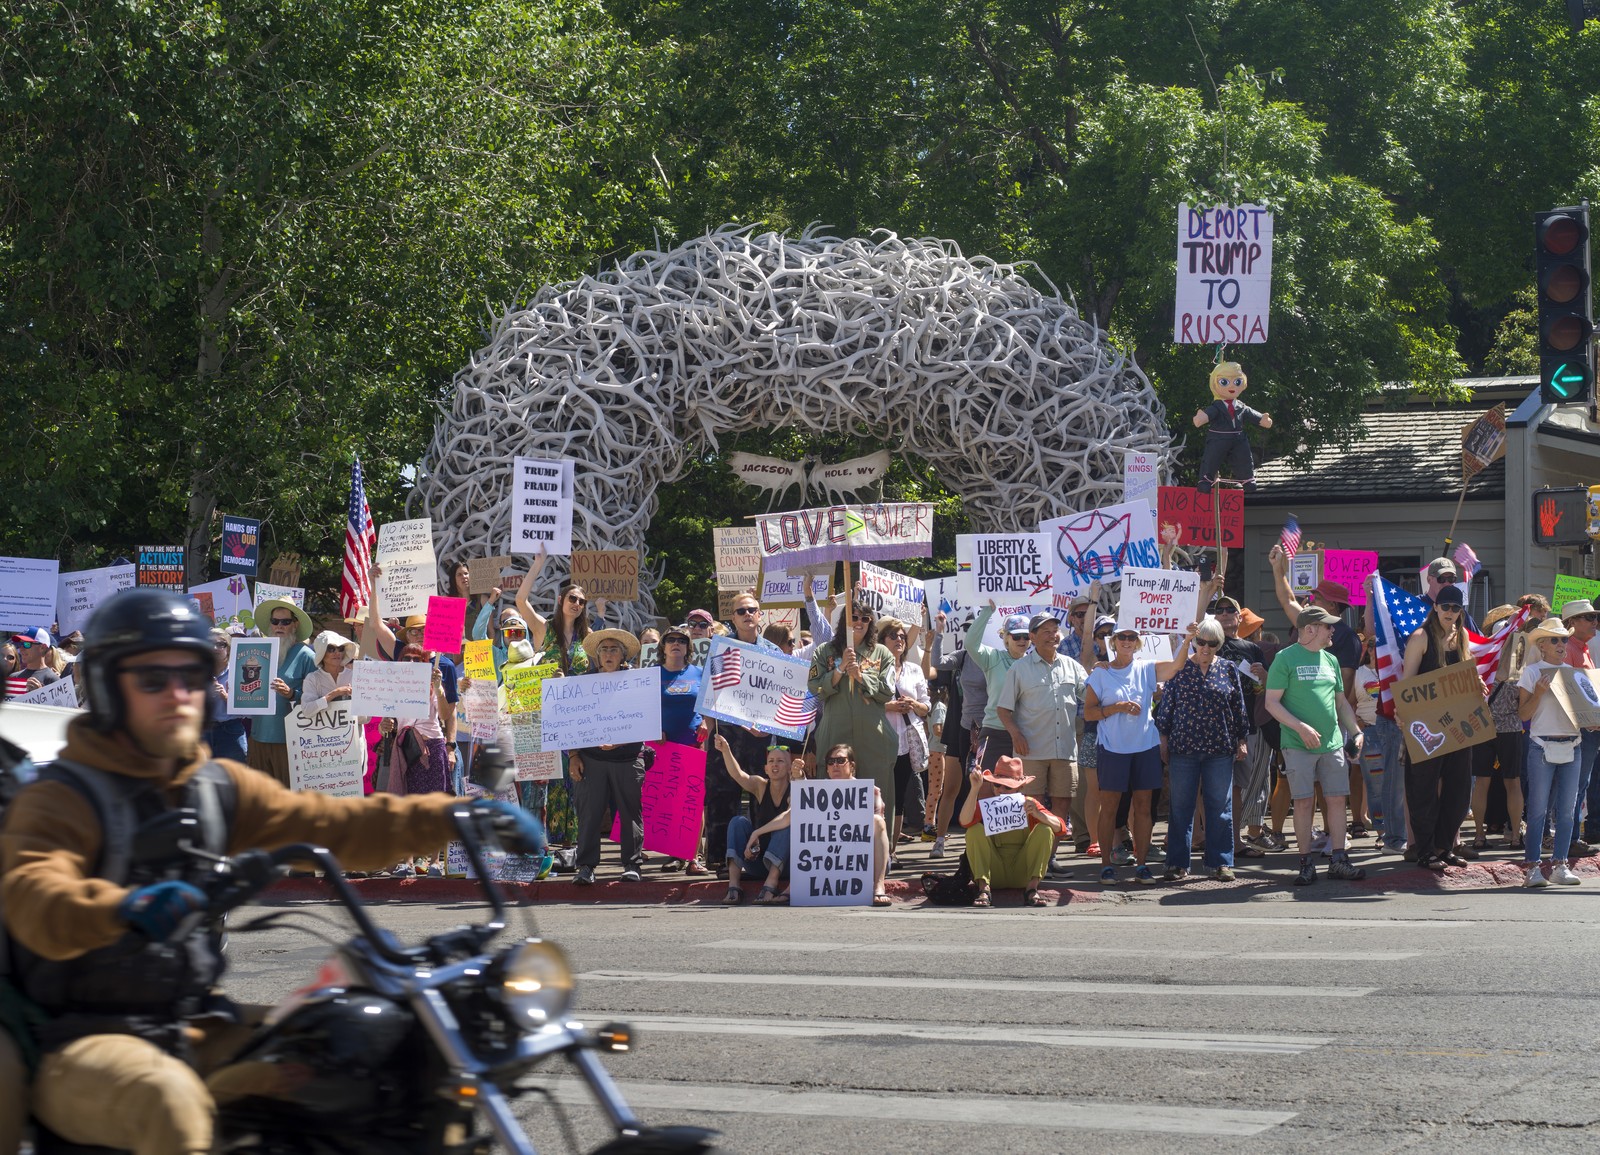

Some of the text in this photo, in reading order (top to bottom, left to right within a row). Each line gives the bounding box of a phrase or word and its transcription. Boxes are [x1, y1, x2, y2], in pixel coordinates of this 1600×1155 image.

[1188, 208, 1267, 240] DEPORT
[1182, 241, 1262, 275] TRUMP
[1200, 278, 1240, 310] TO
[1181, 313, 1267, 344] RUSSIA
[1135, 456, 1146, 464] NO
[524, 466, 559, 477] TRUMP
[742, 464, 793, 476] JACKSON
[857, 467, 875, 475] WY
[524, 481, 558, 492] FRAUD
[524, 498, 558, 507] ABUSER
[1163, 492, 1188, 512] NO
[523, 514, 556, 524] FELON
[225, 522, 257, 535] HANDS OFF
[384, 522, 425, 535] NO KINGS
[522, 529, 554, 540] SCUM
[760, 505, 847, 554] LOVE
[863, 504, 930, 539] POWER
[1188, 526, 1234, 542] TUD
[241, 534, 256, 546] OUR
[720, 547, 751, 556] RUINING
[977, 539, 1037, 555] LIBERTY &
[139, 552, 184, 565] ACTIVIST
[223, 555, 256, 567] DEMOCRACY
[572, 554, 637, 576] NO KINGS
[977, 554, 1042, 576] JUSTICE
[1066, 537, 1161, 587] NO KINGS
[139, 571, 184, 584] HISTORY
[861, 561, 888, 577] LOOKING
[890, 572, 905, 584] FOR
[65, 578, 93, 587] PROTECT
[764, 580, 793, 594] FEDERAL
[978, 576, 1026, 592] FOR ALL
[1172, 579, 1196, 592] About
[1140, 591, 1172, 604] POWER
[998, 605, 1032, 617] PREVENT
[1150, 607, 1169, 616] NOT
[1134, 617, 1178, 629] PEOPLE
[474, 652, 489, 663] NOT
[783, 667, 794, 680] is
[48, 682, 68, 700] TIME
[240, 680, 261, 692] RESIST
[591, 680, 629, 696] CHANGE
[634, 677, 651, 688] THE
[1401, 682, 1437, 703] GIVE
[542, 719, 576, 730] PROTECT
[1438, 711, 1454, 728] THE
[300, 736, 313, 747] DUE
[317, 734, 341, 743] PROCESS
[542, 733, 559, 742] ICE
[577, 728, 597, 737] BEST
[301, 750, 318, 759] RULE
[652, 752, 682, 836] WANTS HIS
[800, 786, 868, 812] NO ONE
[679, 774, 705, 840] ORWELL
[995, 805, 1008, 815] NO
[826, 811, 840, 820] IS
[995, 813, 1022, 827] KINGS
[800, 823, 871, 843] ILLEGAL
[827, 845, 842, 854] ON
[797, 849, 869, 872] STOLEN
[809, 876, 863, 897] LAND
